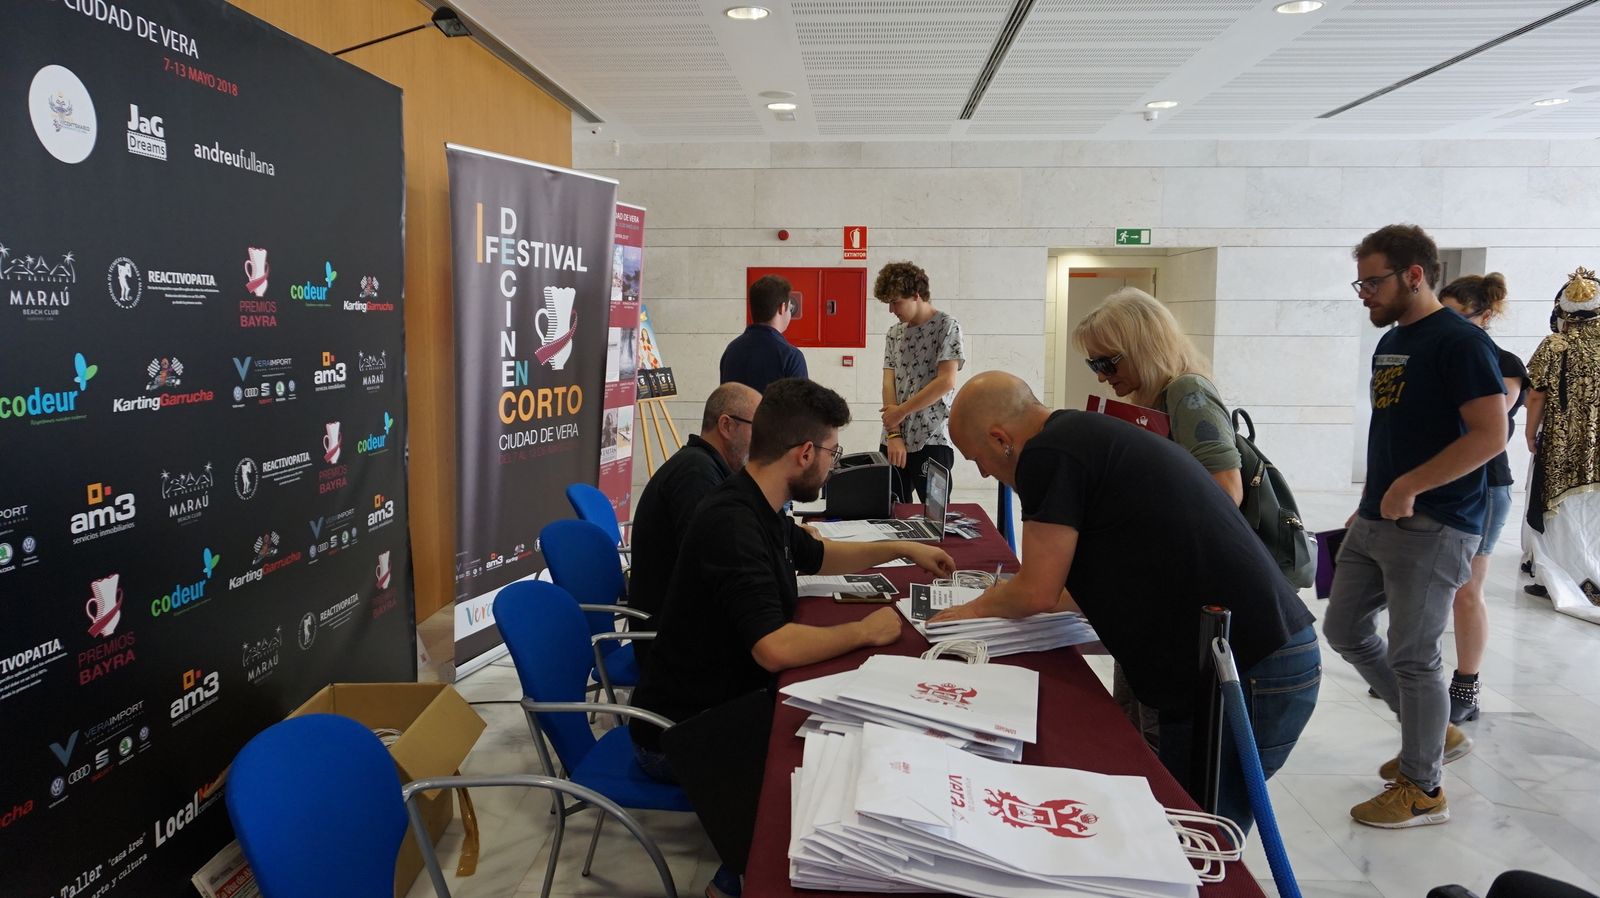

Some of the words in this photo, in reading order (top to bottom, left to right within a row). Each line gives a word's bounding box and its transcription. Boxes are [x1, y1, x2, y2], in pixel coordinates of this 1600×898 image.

[136, 15, 159, 44] DE
[159, 25, 200, 60] VERA
[164, 57, 186, 78] 7-13
[188, 65, 215, 88] MAYO
[216, 79, 239, 97] 2018
[127, 103, 165, 138] JaG
[129, 134, 166, 156] Dreams
[486, 235, 588, 272] FESTIVAL
[148, 269, 217, 287] REACTIVOPATIA
[290, 280, 328, 301] codeur
[10, 286, 70, 307] MARAÚ
[239, 300, 277, 315] PREMIOS
[240, 315, 278, 328] BAYRA
[314, 362, 347, 386] am3
[363, 371, 384, 386] MARAÚ
[0, 386, 79, 419] codeur
[498, 384, 584, 425] CORTO
[357, 433, 386, 454] codeur
[499, 427, 539, 451] CIUDAD
[540, 426, 555, 443] DE
[556, 422, 580, 440] VERA
[262, 451, 311, 473] REACTIVOPATIA
[70, 493, 137, 535] am3
[169, 490, 210, 518] MARAÚ
[367, 499, 395, 527] am3
[151, 580, 207, 618] codeur
[80, 649, 137, 687] BAYRA
[169, 671, 220, 720] am3
[117, 852, 148, 880] cultura
